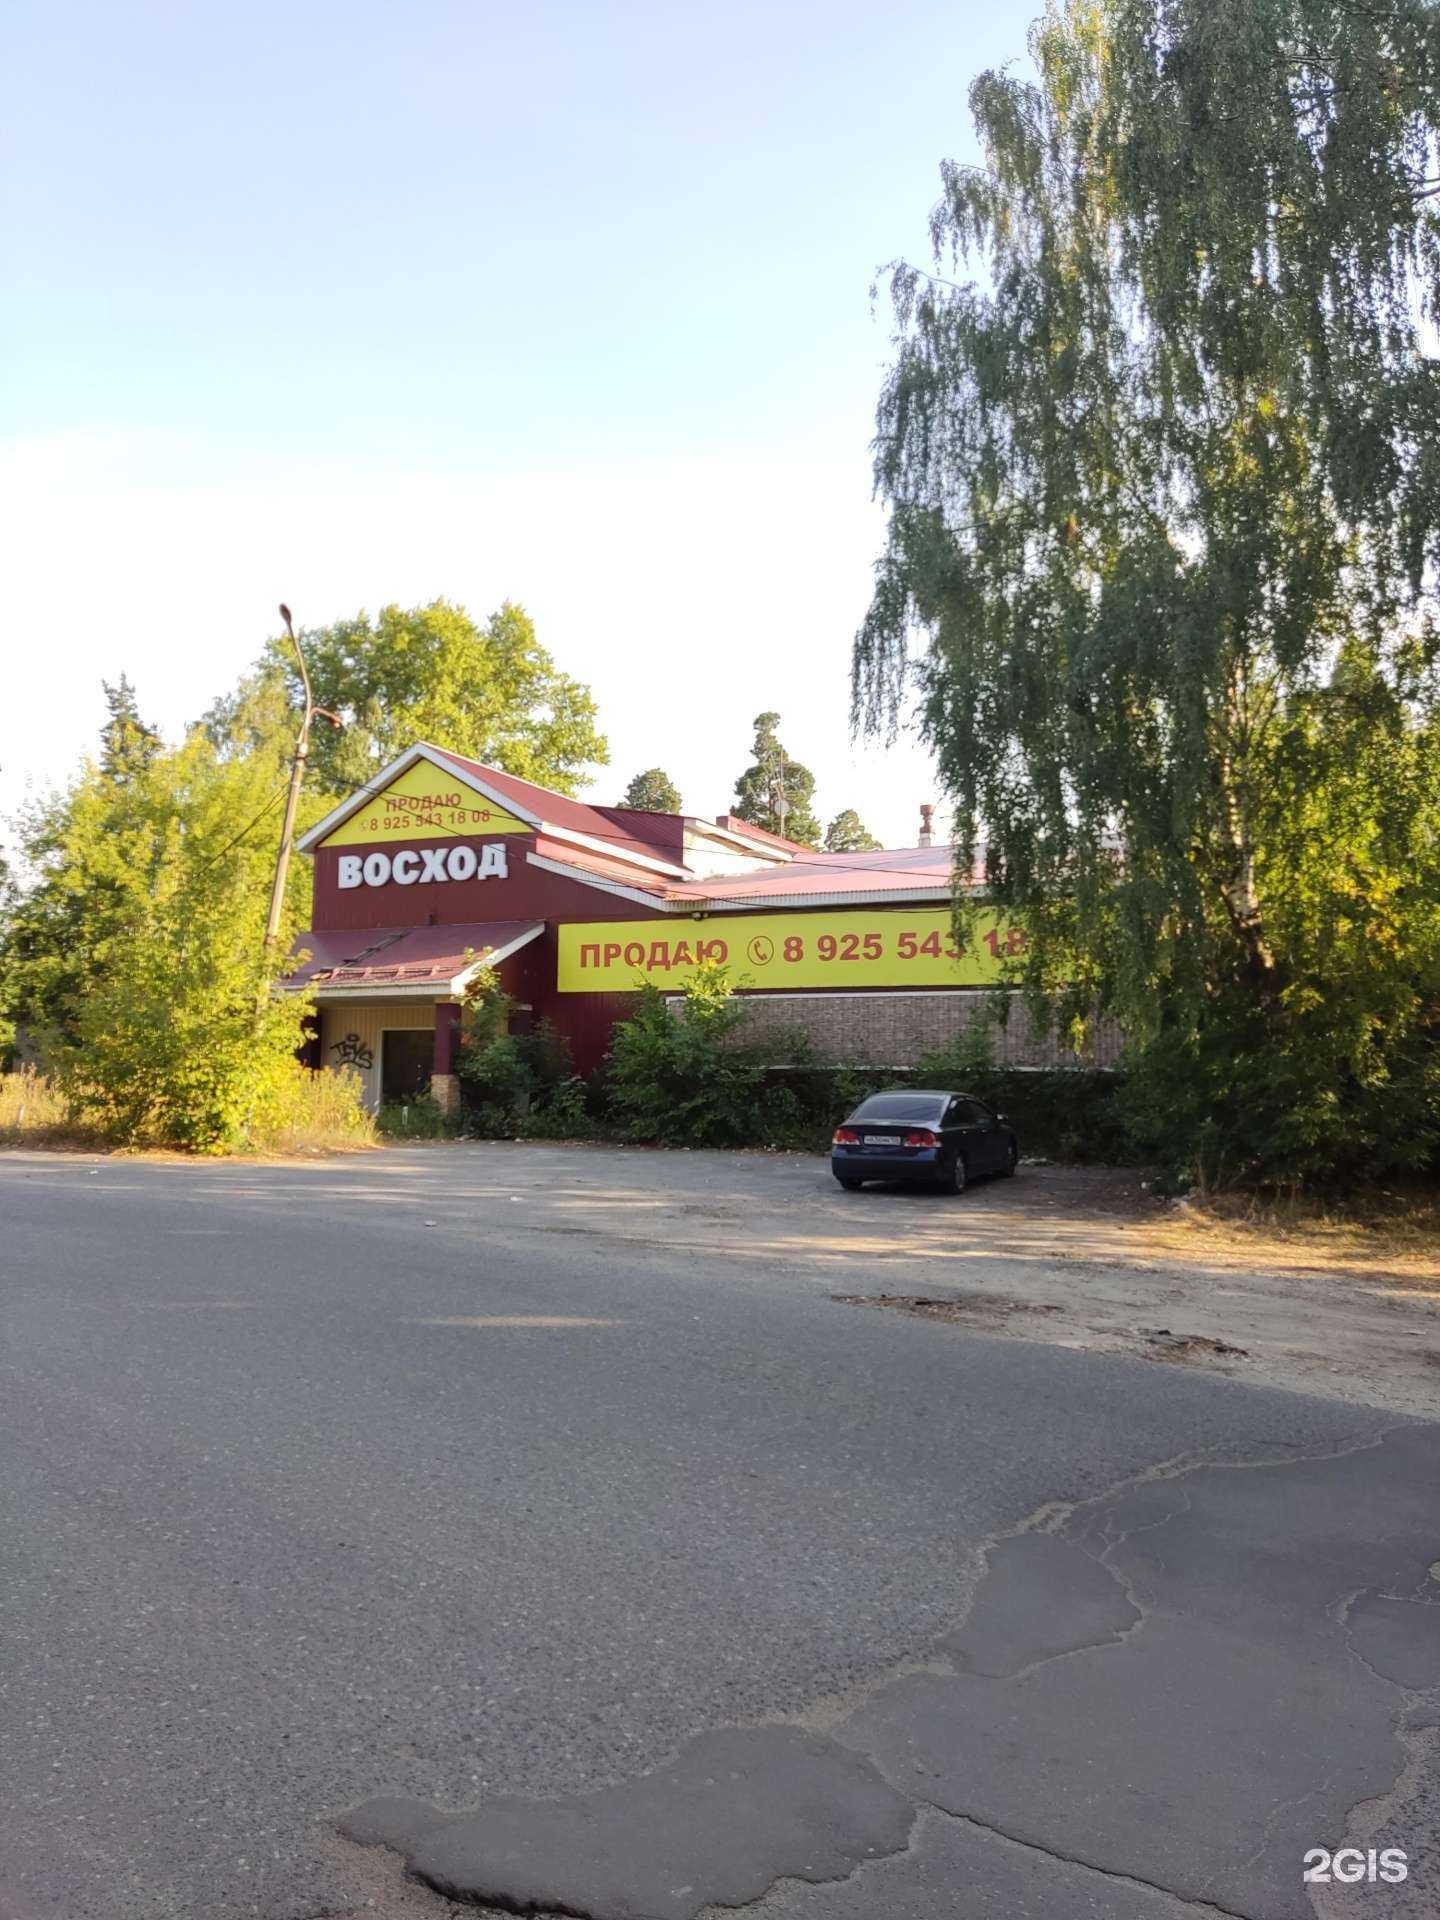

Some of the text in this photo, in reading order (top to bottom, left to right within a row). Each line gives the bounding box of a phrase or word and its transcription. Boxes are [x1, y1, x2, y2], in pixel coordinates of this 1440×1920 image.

[385, 793, 462, 813] ПРОДАЮ
[369, 809, 490, 831] 8 925 543 18 08
[337, 843, 508, 889] ВОСХОД
[580, 939, 729, 971] ПРОДАЮ
[783, 936, 804, 962] 8
[817, 933, 883, 961] 925
